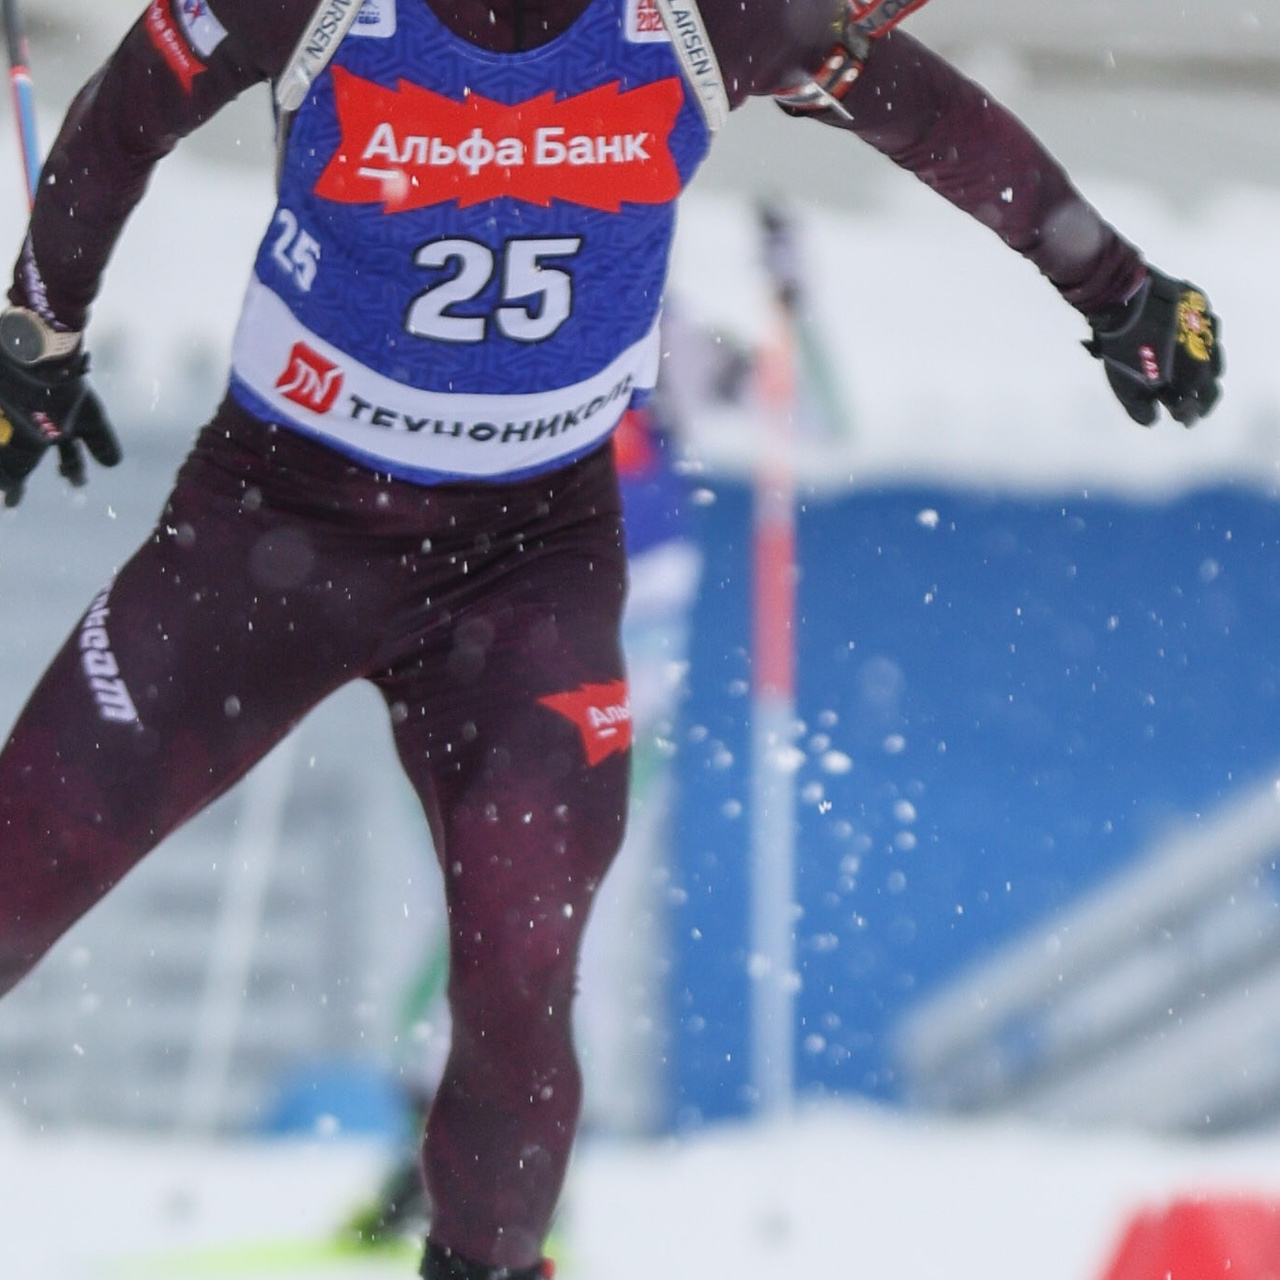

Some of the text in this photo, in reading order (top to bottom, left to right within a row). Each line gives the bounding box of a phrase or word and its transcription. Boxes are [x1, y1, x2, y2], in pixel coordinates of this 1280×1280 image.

[361, 122, 651, 177] Альфа Банк
[272, 208, 321, 292] 25
[405, 236, 582, 342] 25
